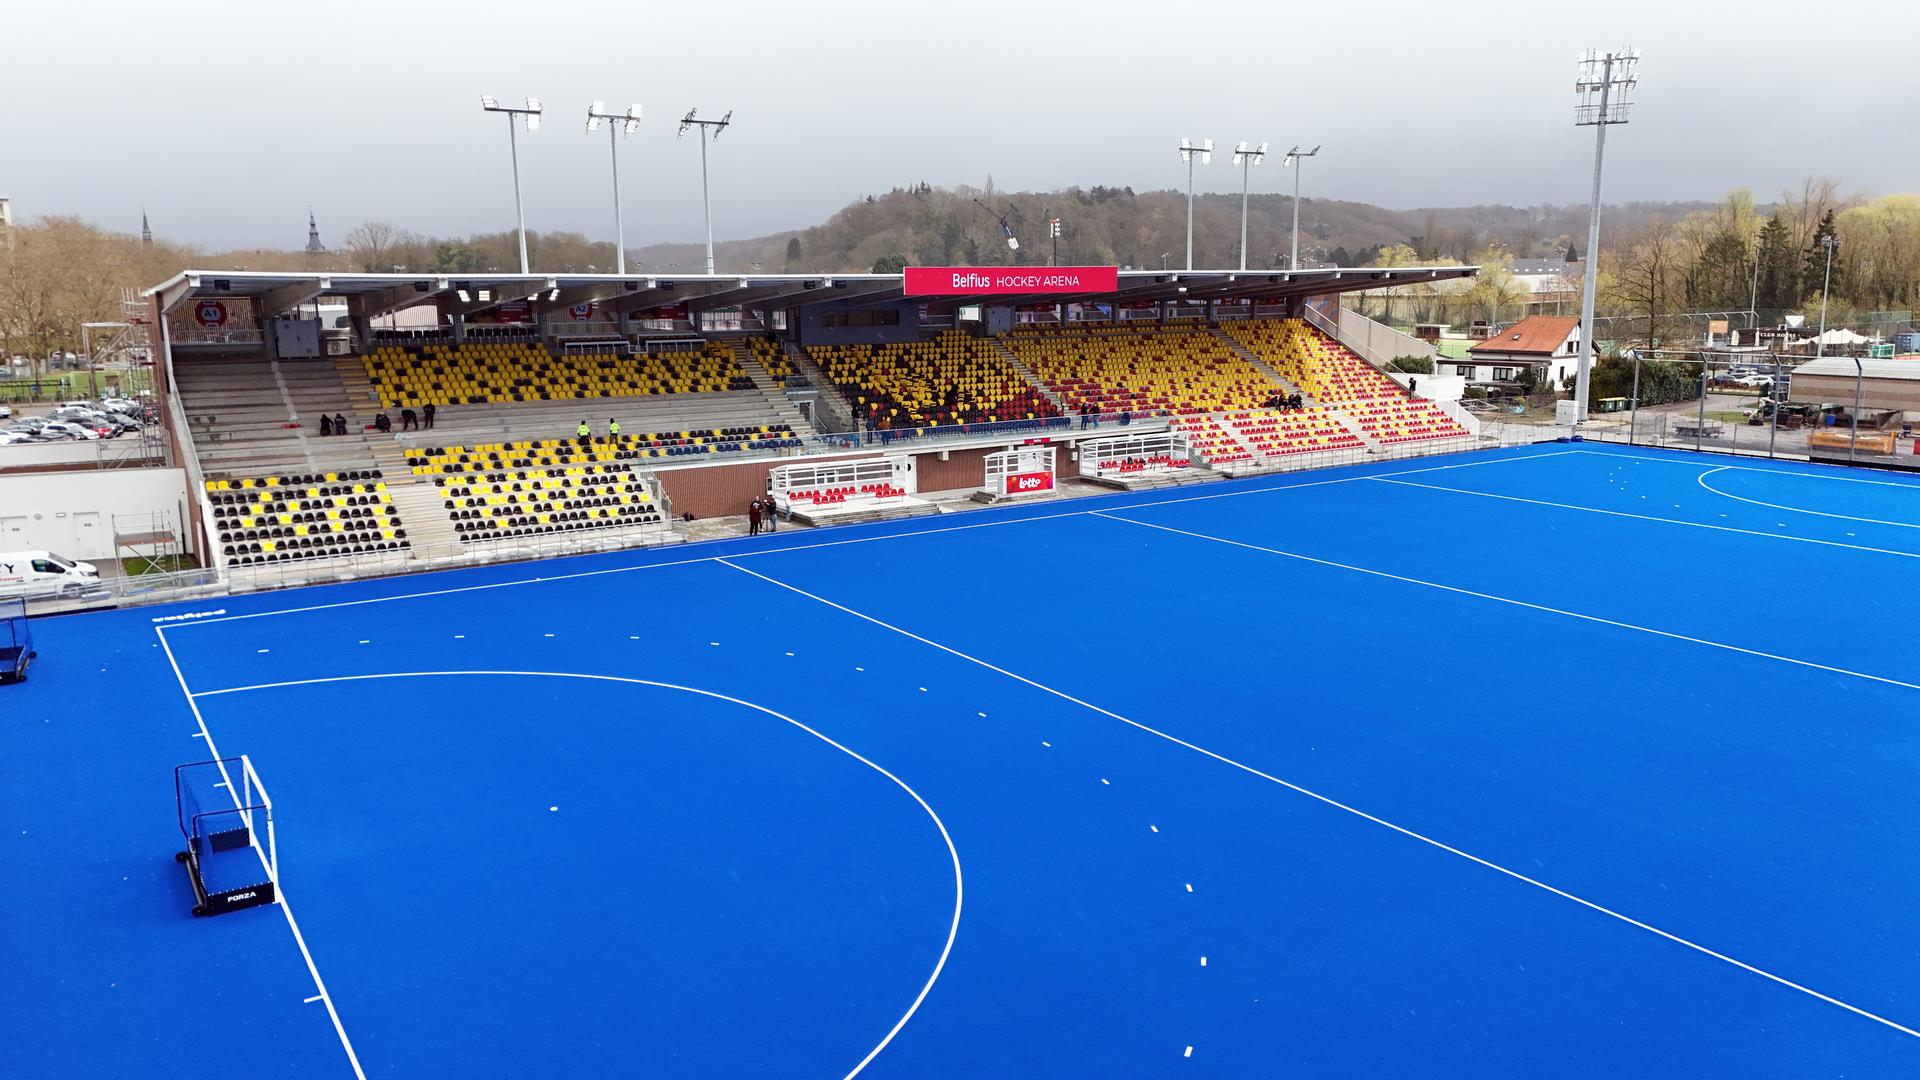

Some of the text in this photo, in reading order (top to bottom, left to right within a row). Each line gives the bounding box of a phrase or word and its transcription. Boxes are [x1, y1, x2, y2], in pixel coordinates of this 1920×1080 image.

[952, 273, 1080, 288] Belfius HOCKEY ARENA
[204, 309, 217, 317] A1
[576, 304, 586, 312] A2
[227, 891, 257, 903] FORZA
